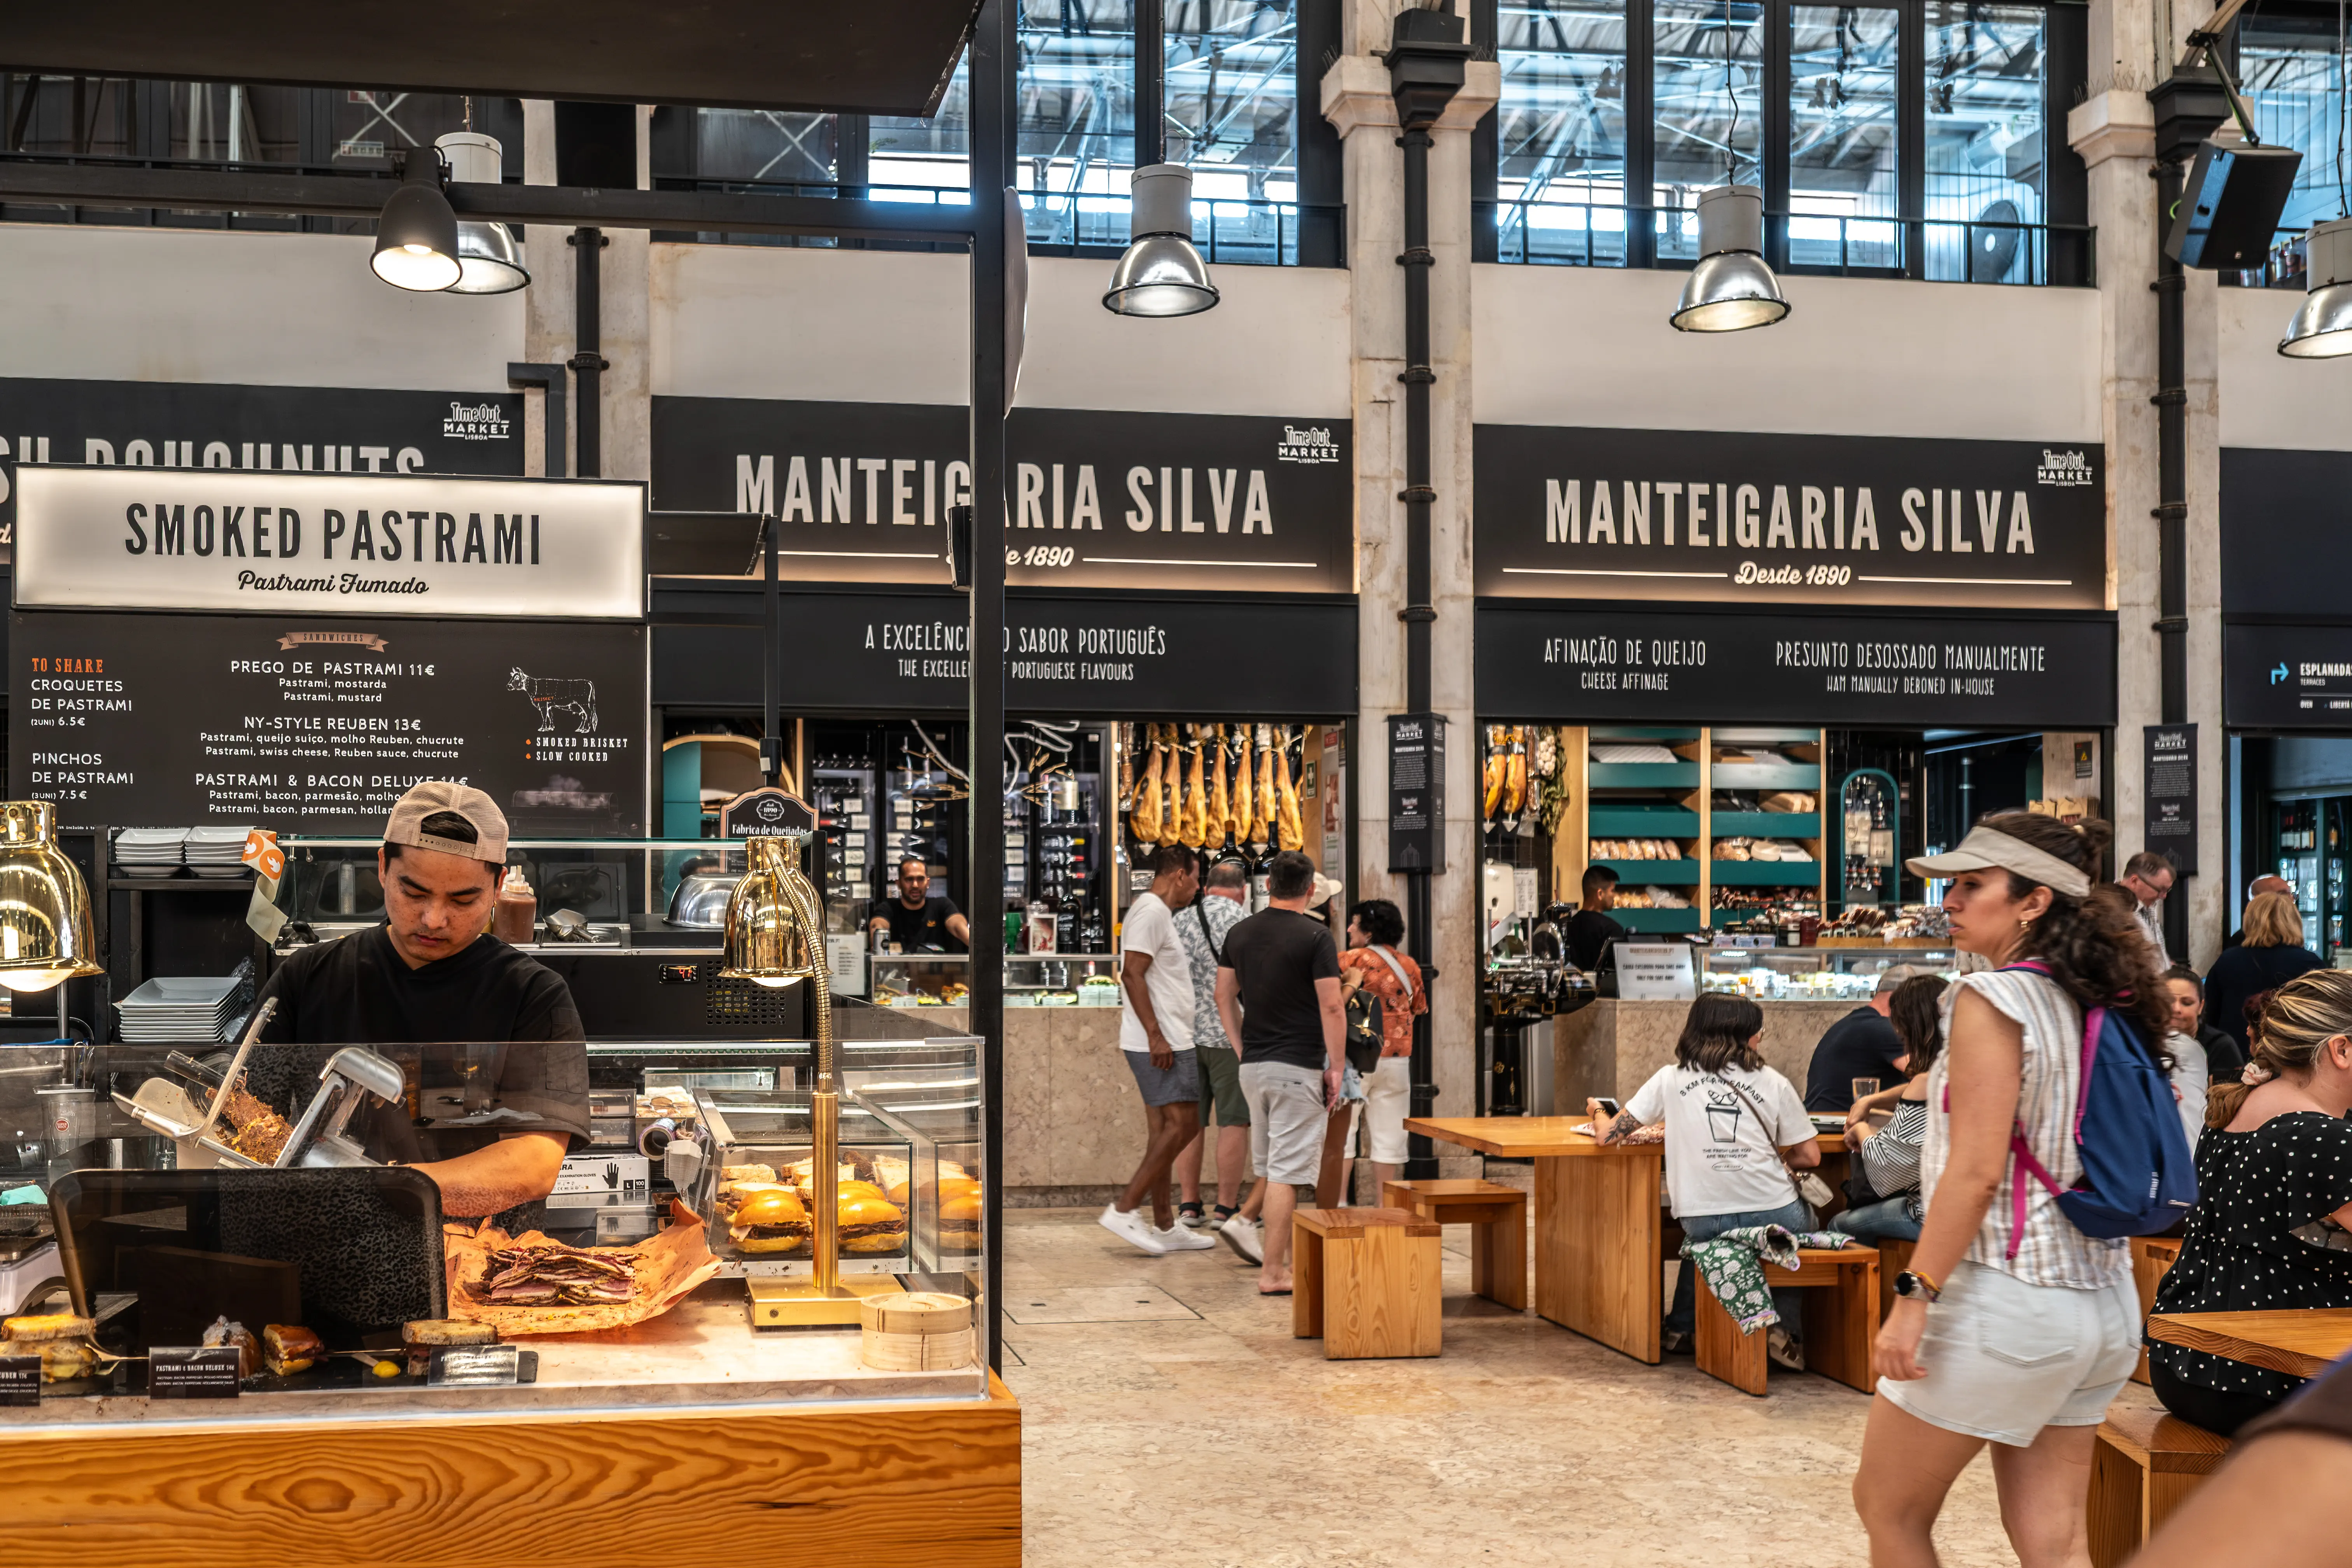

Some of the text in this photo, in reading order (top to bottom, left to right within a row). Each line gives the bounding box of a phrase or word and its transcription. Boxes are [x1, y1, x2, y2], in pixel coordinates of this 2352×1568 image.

[450, 402, 500, 423] Time Out
[444, 423, 509, 434] MARKET
[1284, 425, 1330, 447] Time Out
[1278, 447, 1339, 458] MARKET
[2043, 449, 2085, 470] Time Out
[2037, 470, 2092, 480] MARKET
[737, 455, 1273, 534] MANTEIGRIA SILVA
[1546, 479, 2034, 554] MANTEIGARIA SILVA
[125, 503, 539, 565] SMOKED PASTRAMI
[1024, 546, 1074, 567] 1890
[1734, 561, 1851, 586] Desde 1890
[238, 569, 429, 596] Pastrami Fumado
[304, 633, 363, 642] SANDWICHES
[865, 621, 1165, 655] A EXCELÊNCI SABOR PORTUGUÊS
[1545, 636, 1705, 667] AFINAÇÃO DE QUEIJO
[1776, 641, 2044, 672] PRESUNTO DESOSSADO MANUALMENTE
[32, 658, 103, 673] TO SHARE
[231, 660, 434, 676] PREGO DE PASTRAMI 11€
[898, 659, 917, 677] THE
[923, 660, 970, 677] EXCELLE
[1012, 661, 1076, 679] PORTUGUESE
[1081, 663, 1134, 681] FLAVOURS
[2300, 662, 2352, 676] ESPLANADA
[31, 679, 123, 692] CROQUETES
[279, 678, 387, 688] Pastrami, mostarda
[1582, 672, 1668, 690] CHEESE AFFINAGE
[1827, 675, 1994, 695] HAM MANUALLY DEBONED IN-HOUSE
[284, 692, 382, 702] Pastrami, mustard
[32, 698, 131, 711] DE PASTRAMI
[2300, 700, 2313, 708] OVEN
[58, 716, 85, 726] 6.5€
[245, 716, 421, 730] NY-STYLE REUBEN 13€
[201, 732, 464, 745] Pastrami, queijo suíço, molho Reuben, chucrute
[536, 737, 628, 748] SMOKED BRISKET
[33, 752, 102, 765] PINCHOS
[206, 746, 256, 756] Pastrami,
[260, 747, 288, 756] swiss
[292, 747, 330, 757] cheese,
[334, 748, 373, 757] Reuben
[412, 749, 458, 758] chucrute
[536, 751, 607, 761] SLOW COOKED
[32, 772, 133, 784] DE PASTRAMI
[196, 773, 277, 786] PASTRAMI
[288, 775, 297, 786] &
[308, 775, 362, 787] BACON
[59, 790, 87, 800] 7.5€
[210, 790, 401, 802] Pastrami, bacon, parmesão, molho
[209, 804, 393, 816] Pastrami, bacon, parmesan, hollan
[732, 824, 807, 836] Fábrica de Queijadas
[1685, 1080, 1699, 1092] KM
